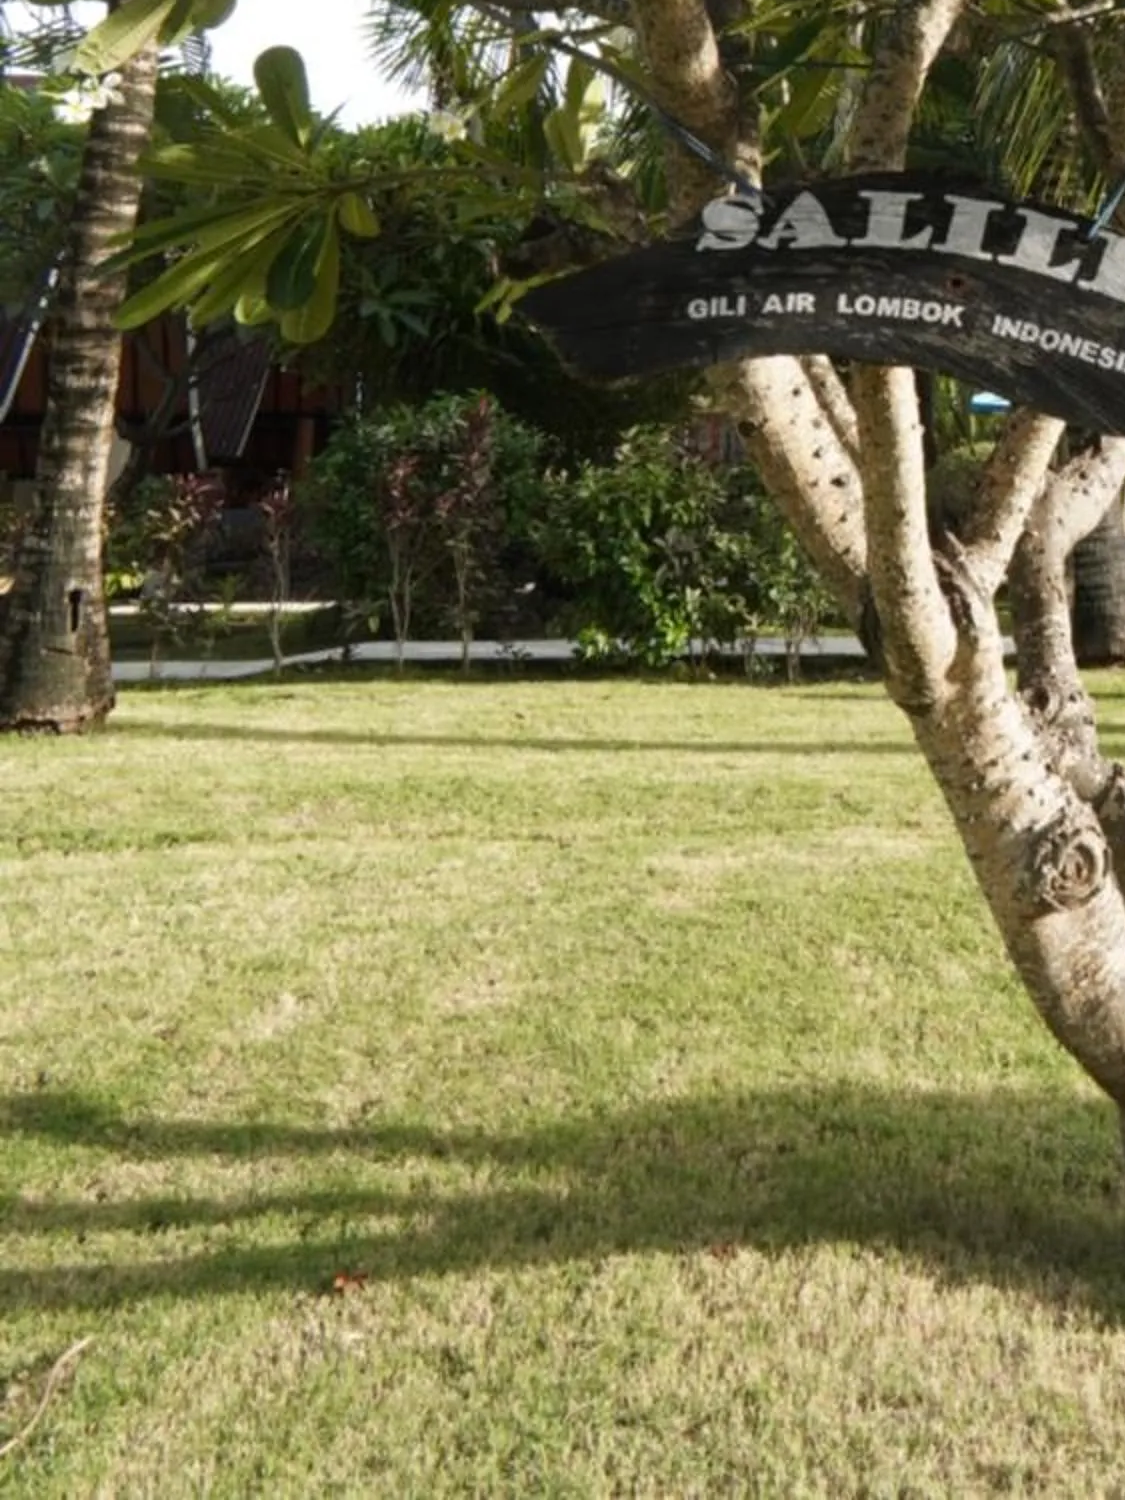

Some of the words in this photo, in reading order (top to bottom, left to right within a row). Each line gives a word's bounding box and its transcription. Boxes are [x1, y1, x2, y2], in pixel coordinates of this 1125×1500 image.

[687, 299, 746, 321] GILI
[761, 292, 816, 315] AIR
[836, 293, 966, 328] LOMBOK
